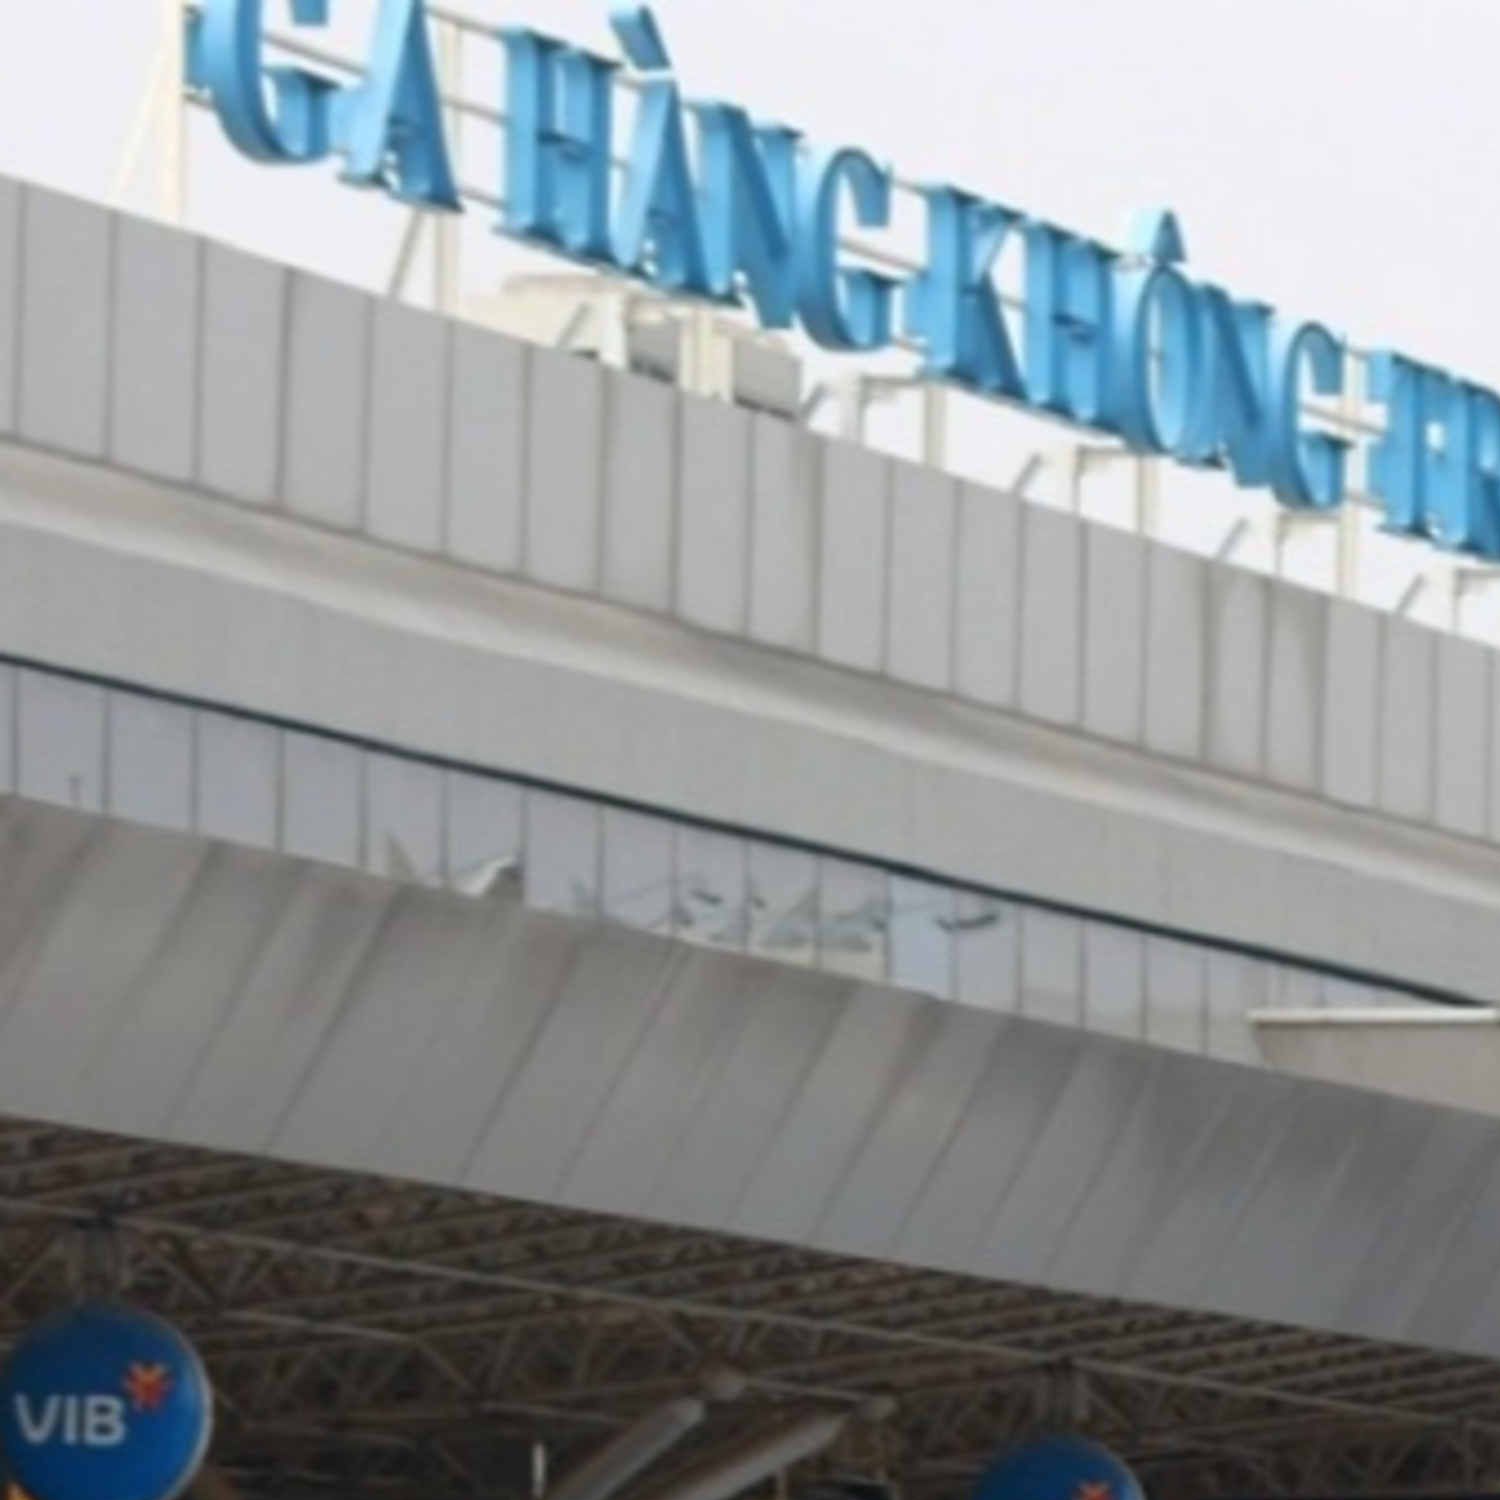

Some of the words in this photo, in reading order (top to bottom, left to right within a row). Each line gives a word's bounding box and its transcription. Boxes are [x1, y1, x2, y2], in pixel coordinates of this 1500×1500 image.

[493, 4, 893, 352] HÀNG
[905, 183, 1354, 511] KHÔNG
[17, 1395, 127, 1445] VIB
